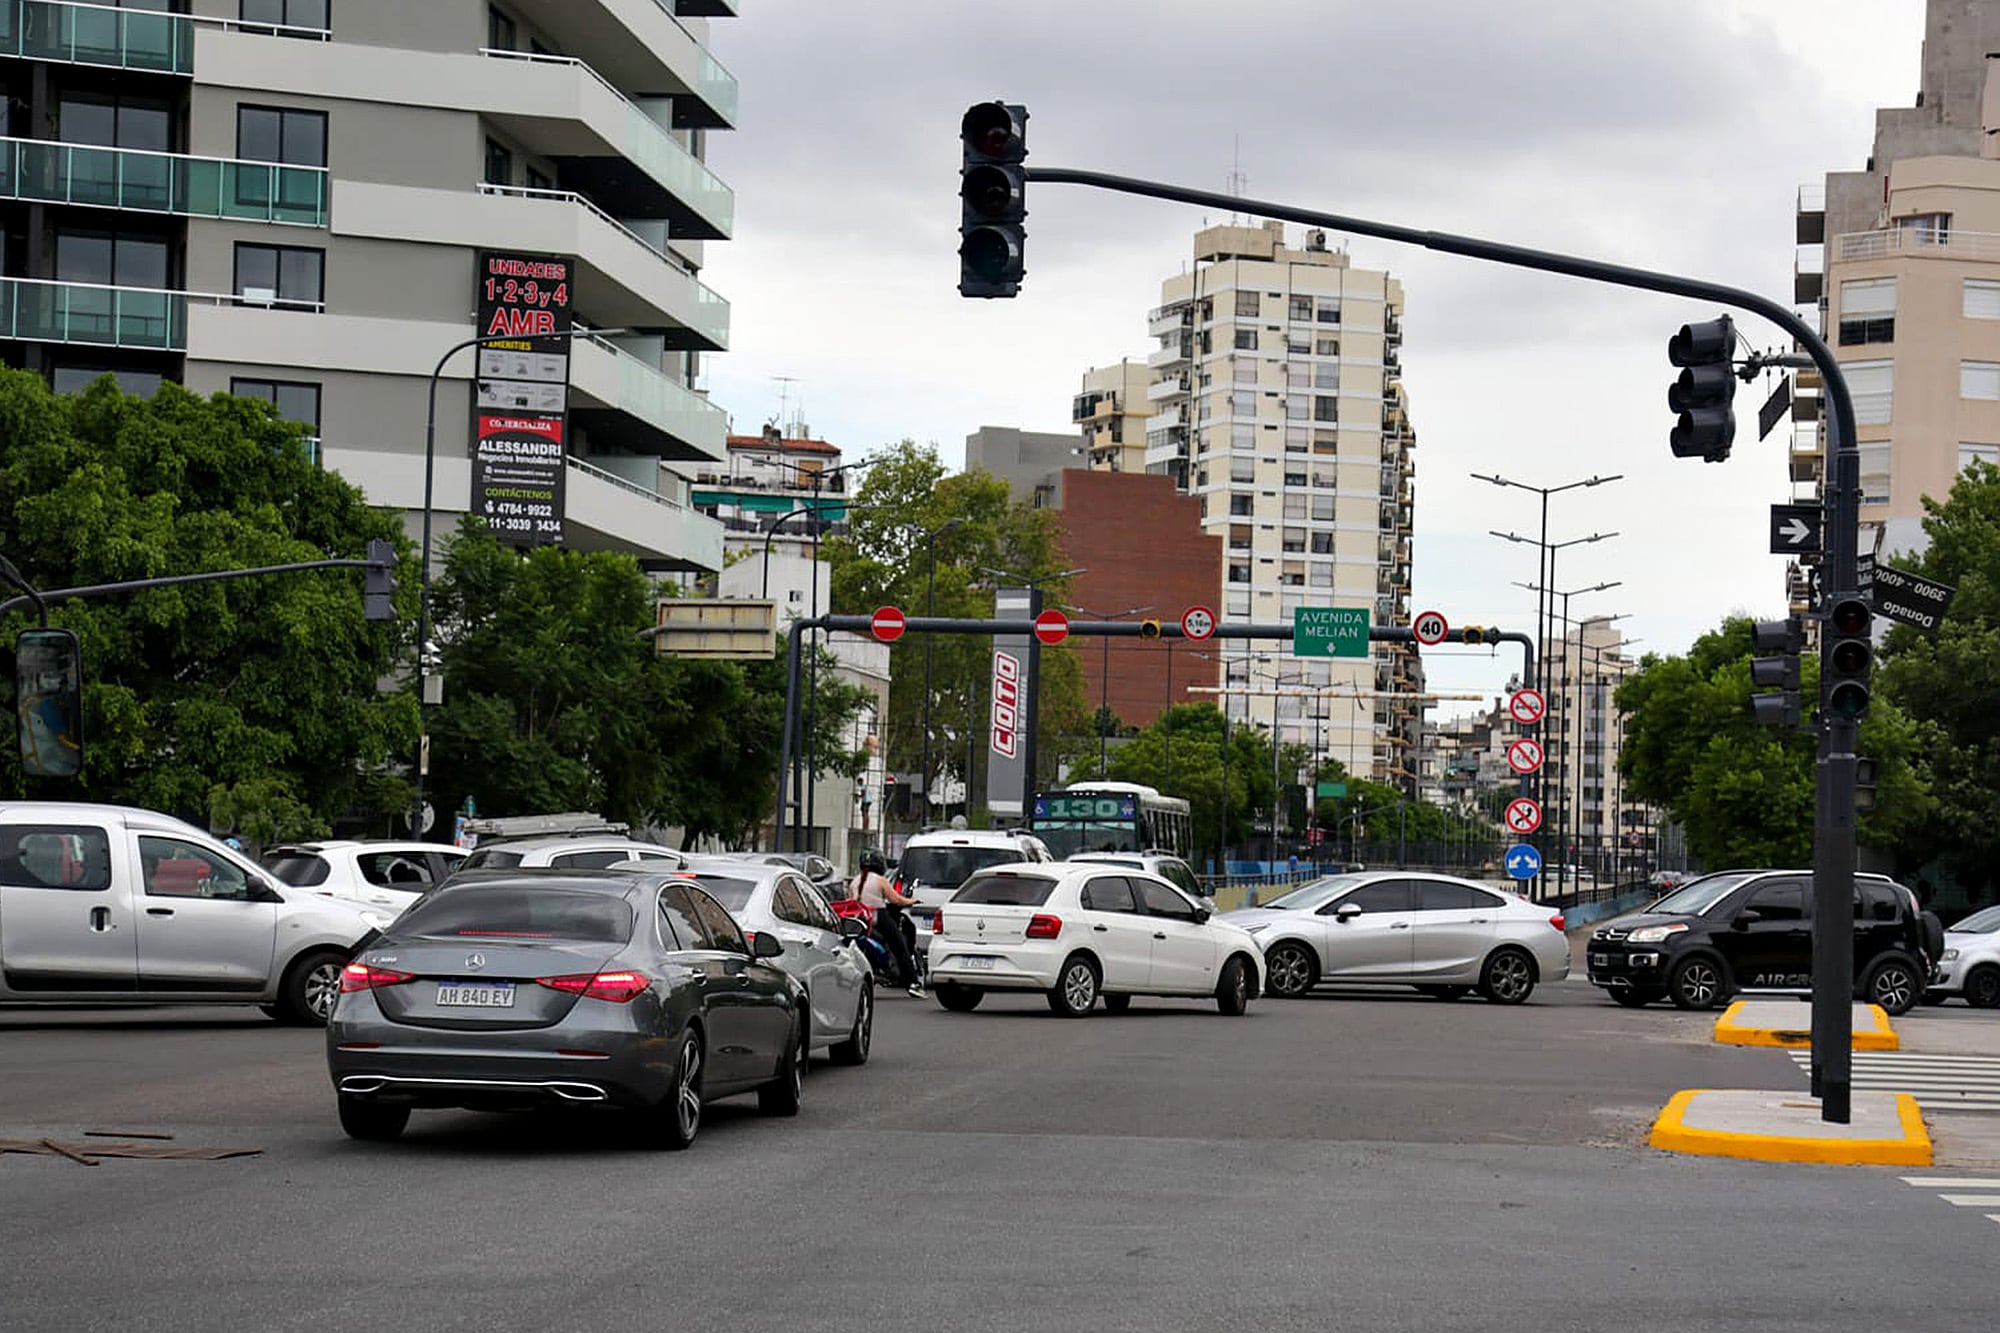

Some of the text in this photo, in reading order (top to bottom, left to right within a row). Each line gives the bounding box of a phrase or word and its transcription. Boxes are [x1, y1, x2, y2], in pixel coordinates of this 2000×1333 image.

[489, 259, 566, 279] UNIDADES
[478, 440, 561, 456] ALESSANDRI
[1914, 583, 1946, 602] 3900
[1301, 612, 1363, 625] AVENIDA
[1883, 601, 1933, 628] Donado
[1305, 627, 1358, 638] MELIAN
[1420, 621, 1441, 636] 40
[991, 651, 1019, 758] COTO
[1050, 799, 1118, 817] 130
[440, 988, 458, 1003] AH
[492, 990, 511, 1005] EY
